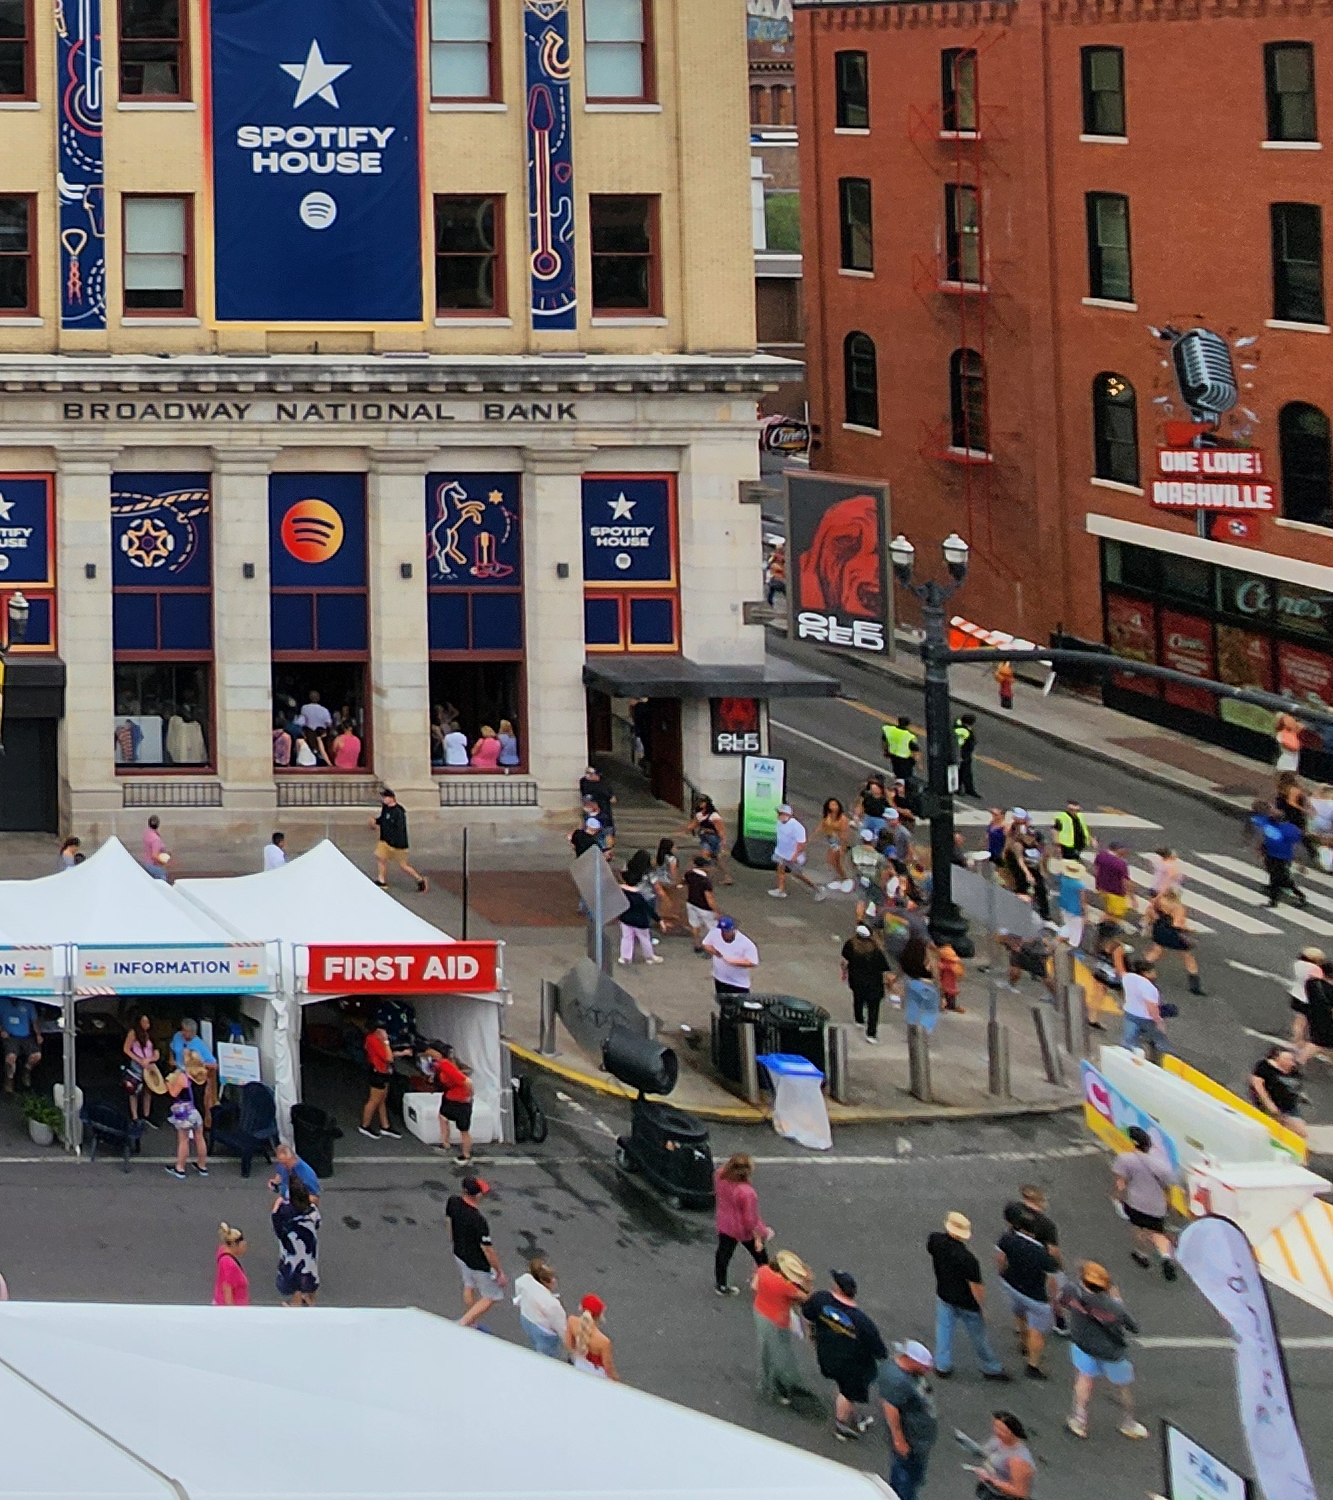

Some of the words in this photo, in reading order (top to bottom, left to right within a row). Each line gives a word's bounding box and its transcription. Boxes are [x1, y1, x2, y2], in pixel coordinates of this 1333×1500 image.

[237, 125, 396, 148] SPOTIFY
[252, 151, 383, 174] HOUSE
[62, 401, 252, 421] BROADWAY
[276, 401, 455, 421] NATIONAL
[484, 402, 578, 422] BANK
[1160, 451, 1200, 474] ONE
[1153, 480, 1274, 510] NASHVILLE
[590, 526, 655, 537] SPOTIFY
[596, 537, 651, 548] HOUSE
[797, 611, 884, 635] OLE
[797, 623, 885, 651] RED
[717, 732, 759, 742] OLE
[717, 741, 760, 752] RED
[113, 959, 230, 976] INFORMATION
[324, 956, 416, 982] FIRST
[422, 956, 480, 980] AID
